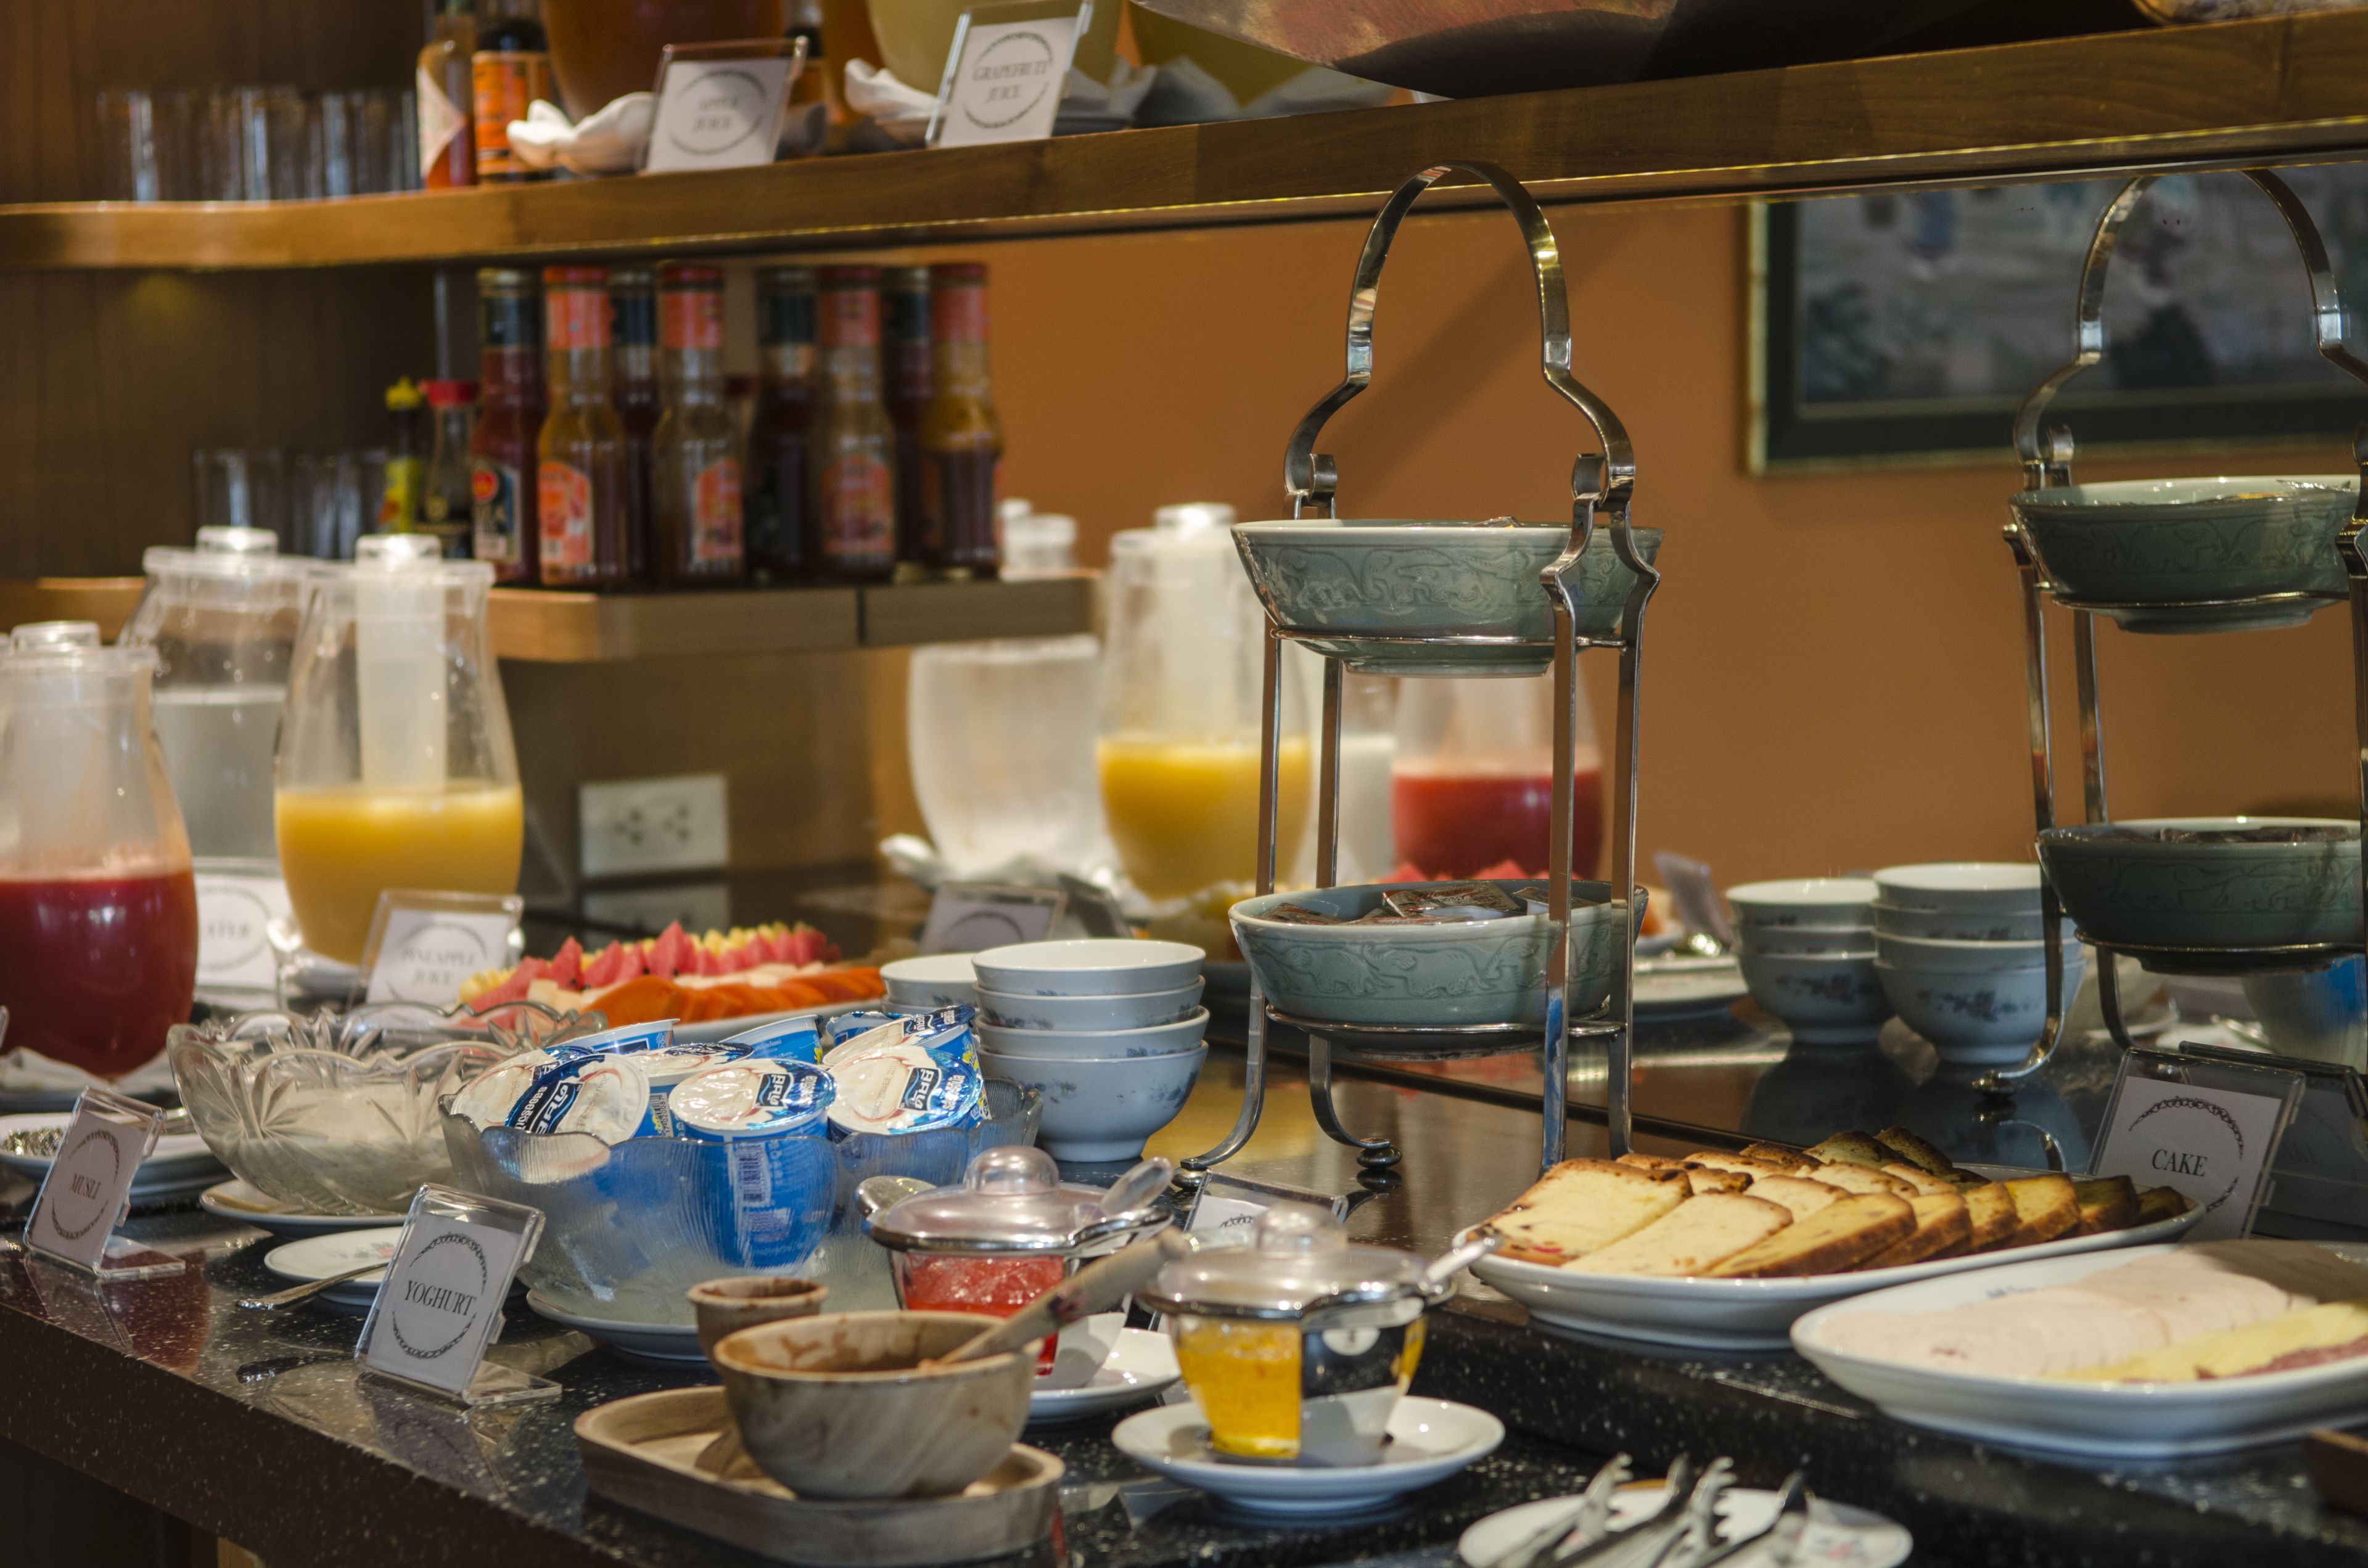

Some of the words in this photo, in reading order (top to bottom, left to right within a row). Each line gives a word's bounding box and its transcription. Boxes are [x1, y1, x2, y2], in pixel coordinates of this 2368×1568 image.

[2152, 1149, 2207, 1176] CAKE
[70, 1173, 101, 1200] MUSLI
[405, 1280, 477, 1315] YOGHURT
